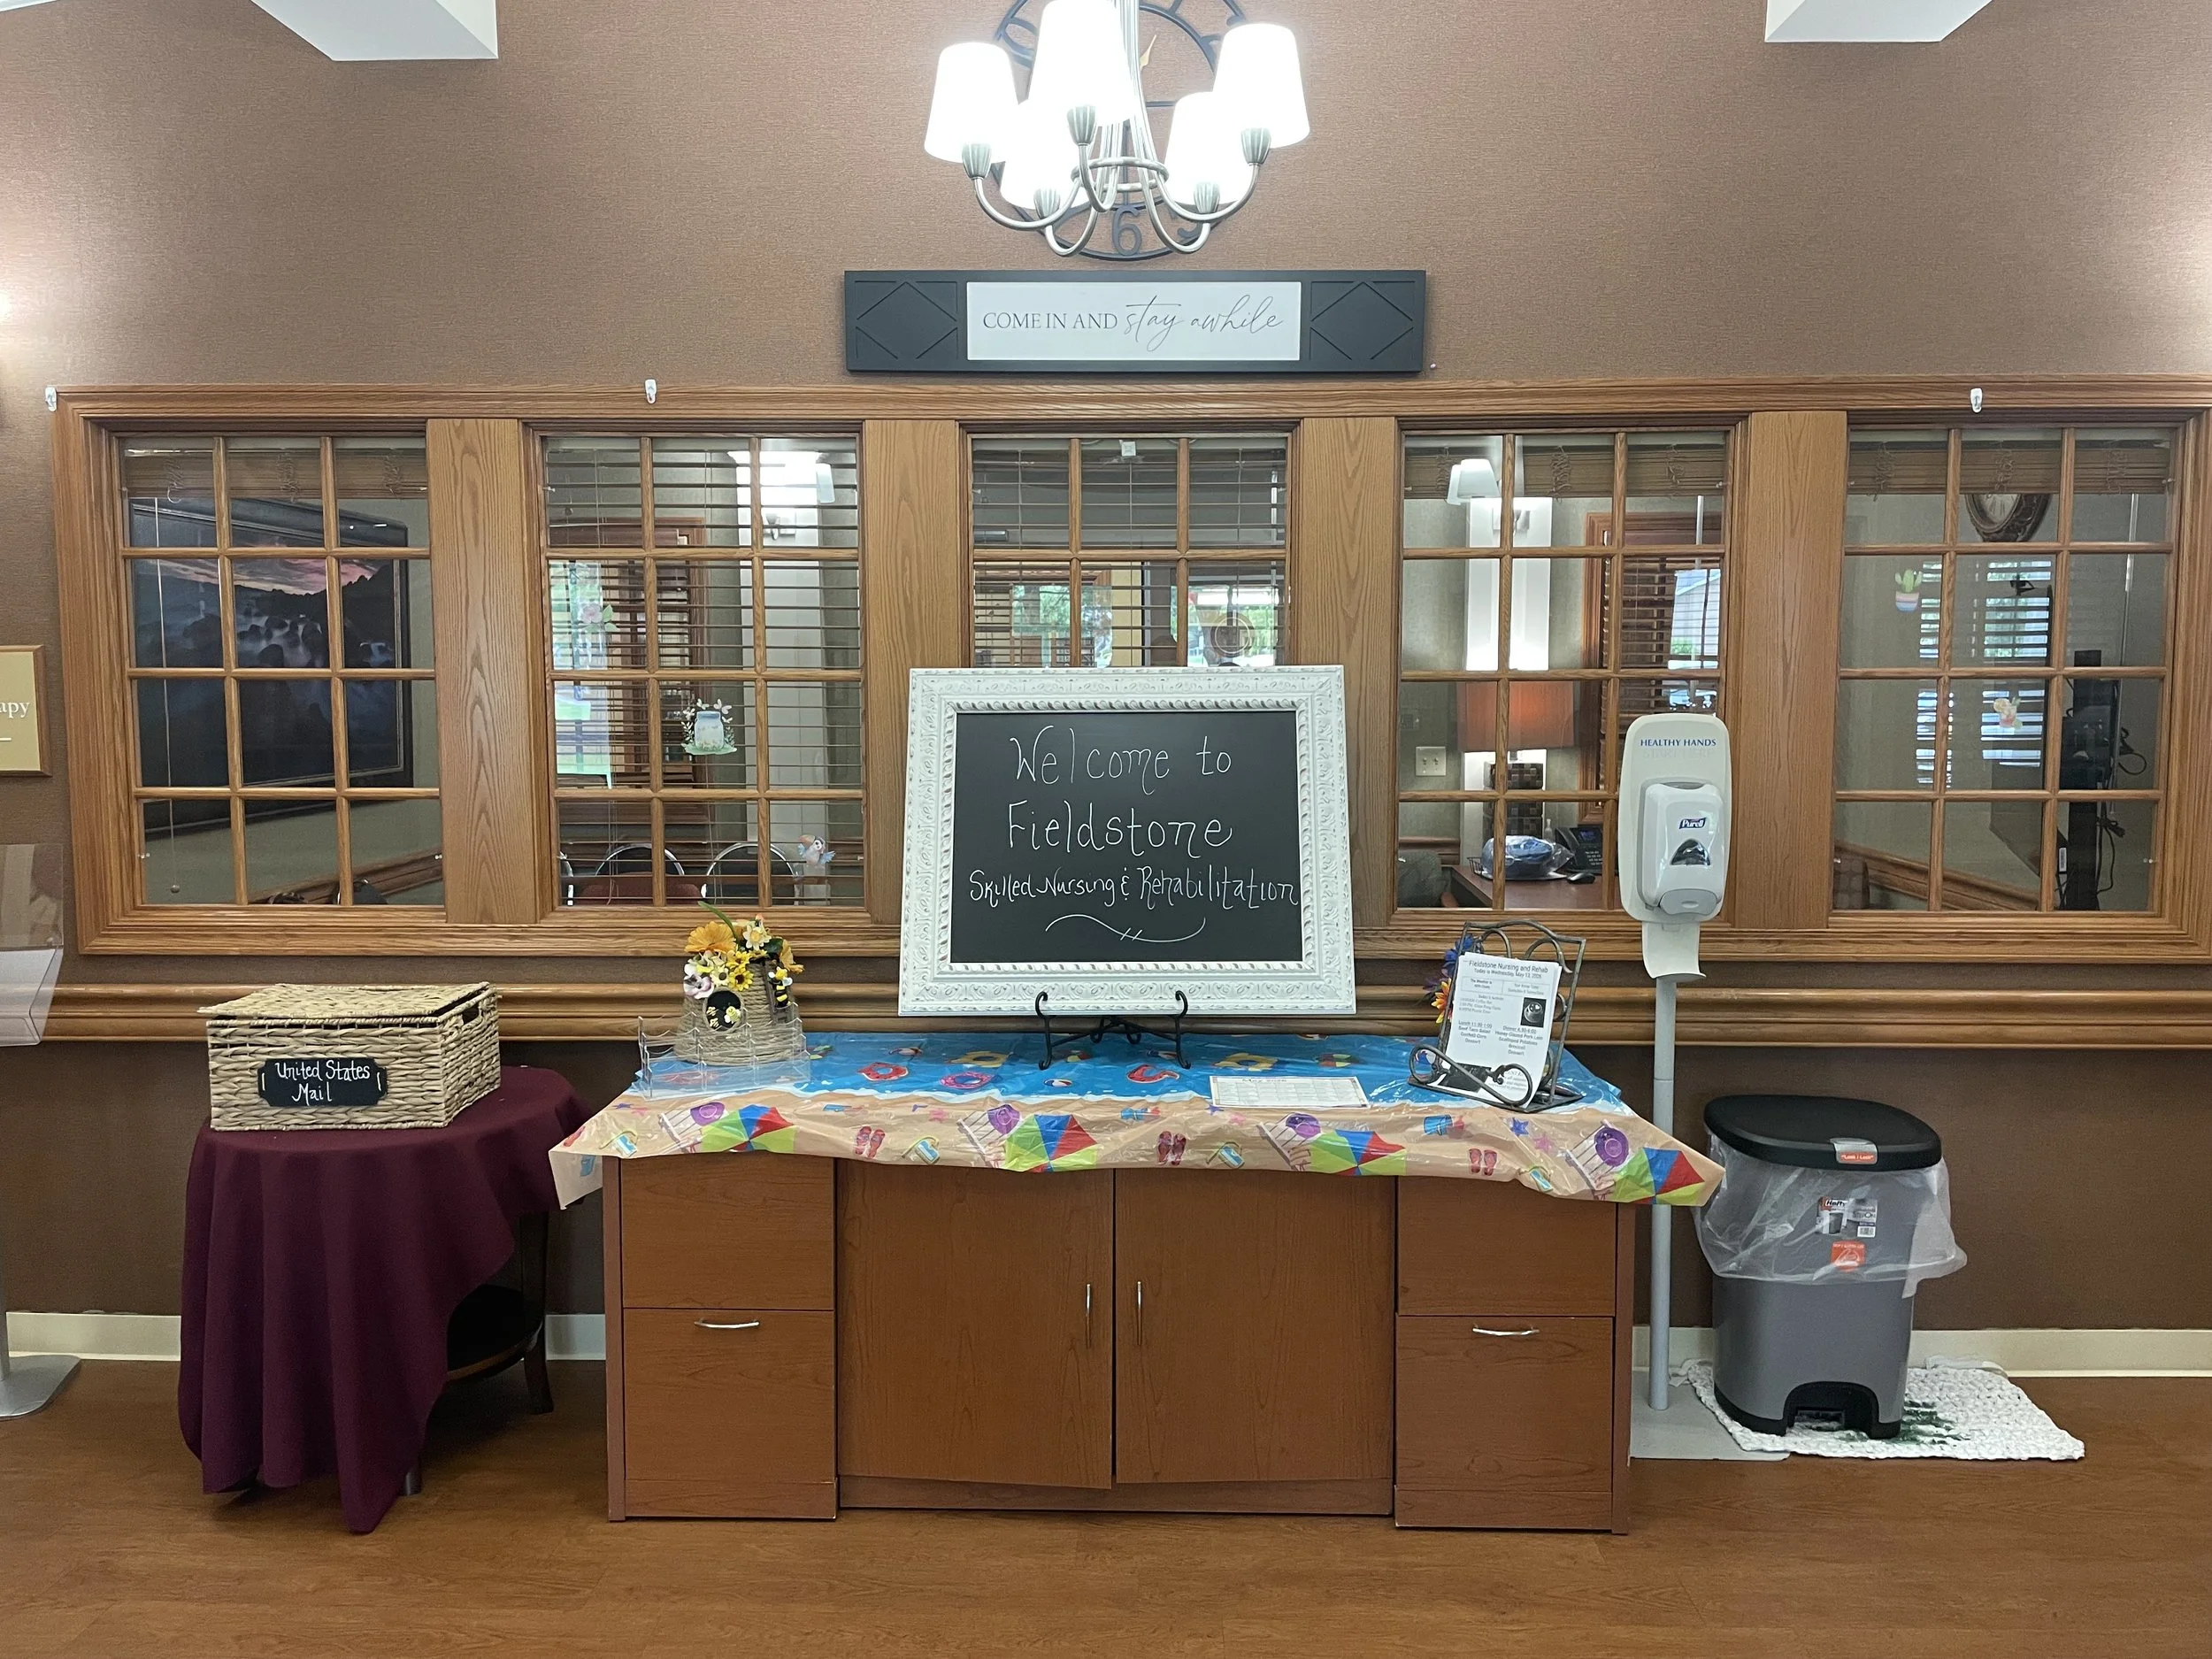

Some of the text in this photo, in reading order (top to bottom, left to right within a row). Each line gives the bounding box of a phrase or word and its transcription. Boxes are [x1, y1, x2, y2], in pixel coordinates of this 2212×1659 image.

[1111, 204, 1142, 256] 6
[982, 294, 1285, 352] COME IN AND stay awhile
[1009, 725, 1233, 795] Welcome to
[1008, 799, 1233, 859] Fieldstone
[969, 870, 1037, 908] Skilled
[1035, 866, 1117, 907] Nursing
[1136, 864, 1299, 910] Rehabilitation
[1469, 960, 1497, 969] Fieldstone
[1498, 963, 1519, 972] Nursing
[274, 1059, 371, 1082] United States
[291, 1081, 333, 1106] Mail
